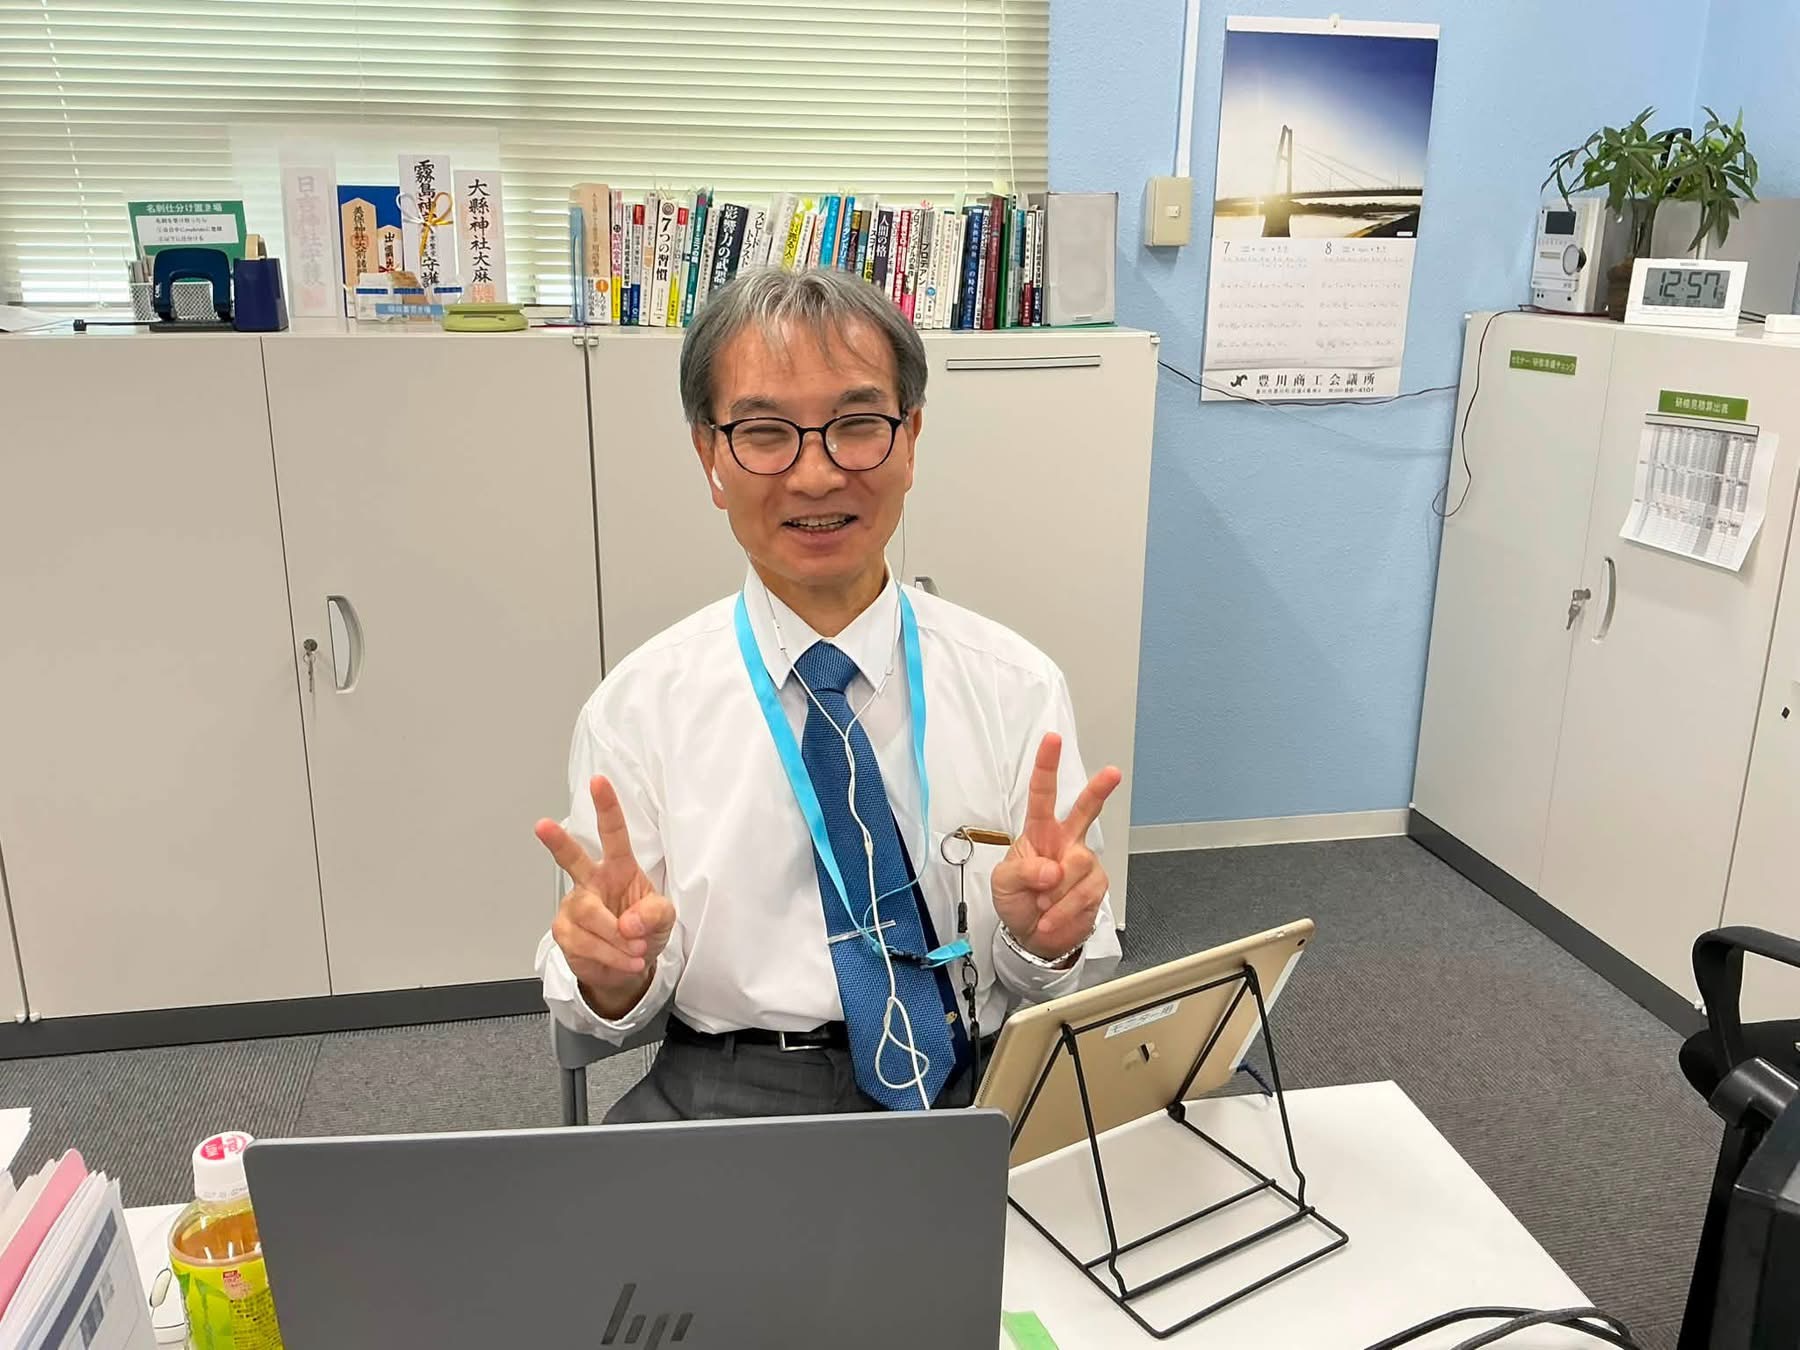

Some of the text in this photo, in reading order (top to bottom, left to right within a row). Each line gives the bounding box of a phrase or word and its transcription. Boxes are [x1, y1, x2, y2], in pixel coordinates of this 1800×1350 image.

[468, 178, 494, 284] 大縣神社大麻
[714, 205, 738, 285] 影響力の武器
[876, 214, 889, 258] 人間の格
[1223, 241, 1231, 254] 7
[1325, 241, 1332, 255] 8
[656, 217, 671, 282] 7つの習慣
[1659, 270, 1721, 299] 12:57
[1258, 372, 1376, 387] 豊川商工会議所
